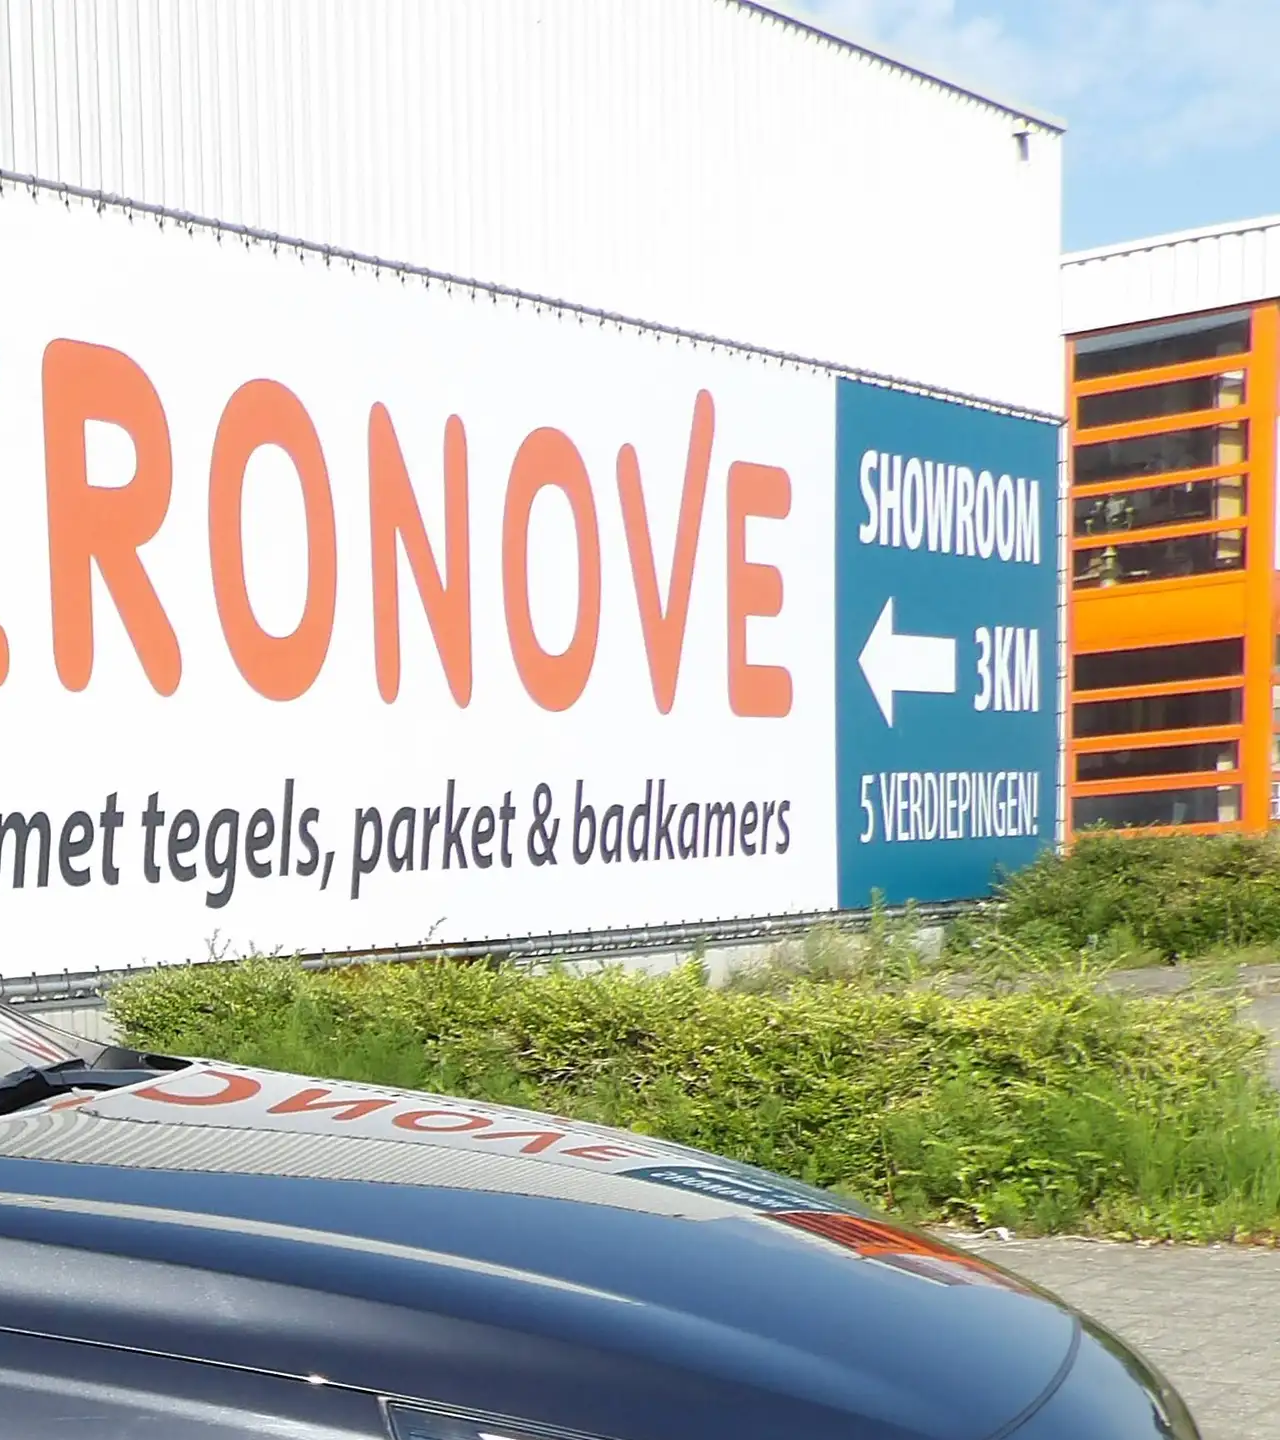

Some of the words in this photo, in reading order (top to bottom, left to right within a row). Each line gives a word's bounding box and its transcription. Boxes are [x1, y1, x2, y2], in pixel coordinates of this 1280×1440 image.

[859, 449, 1041, 565] SHOWROOM
[973, 625, 1041, 713] 3KM
[141, 778, 336, 909] tegels,
[350, 778, 517, 900] parket
[527, 782, 561, 867] &
[572, 778, 791, 865] badkamers
[860, 774, 875, 843] 5
[879, 771, 1040, 842] VERDIEPINGEN!
